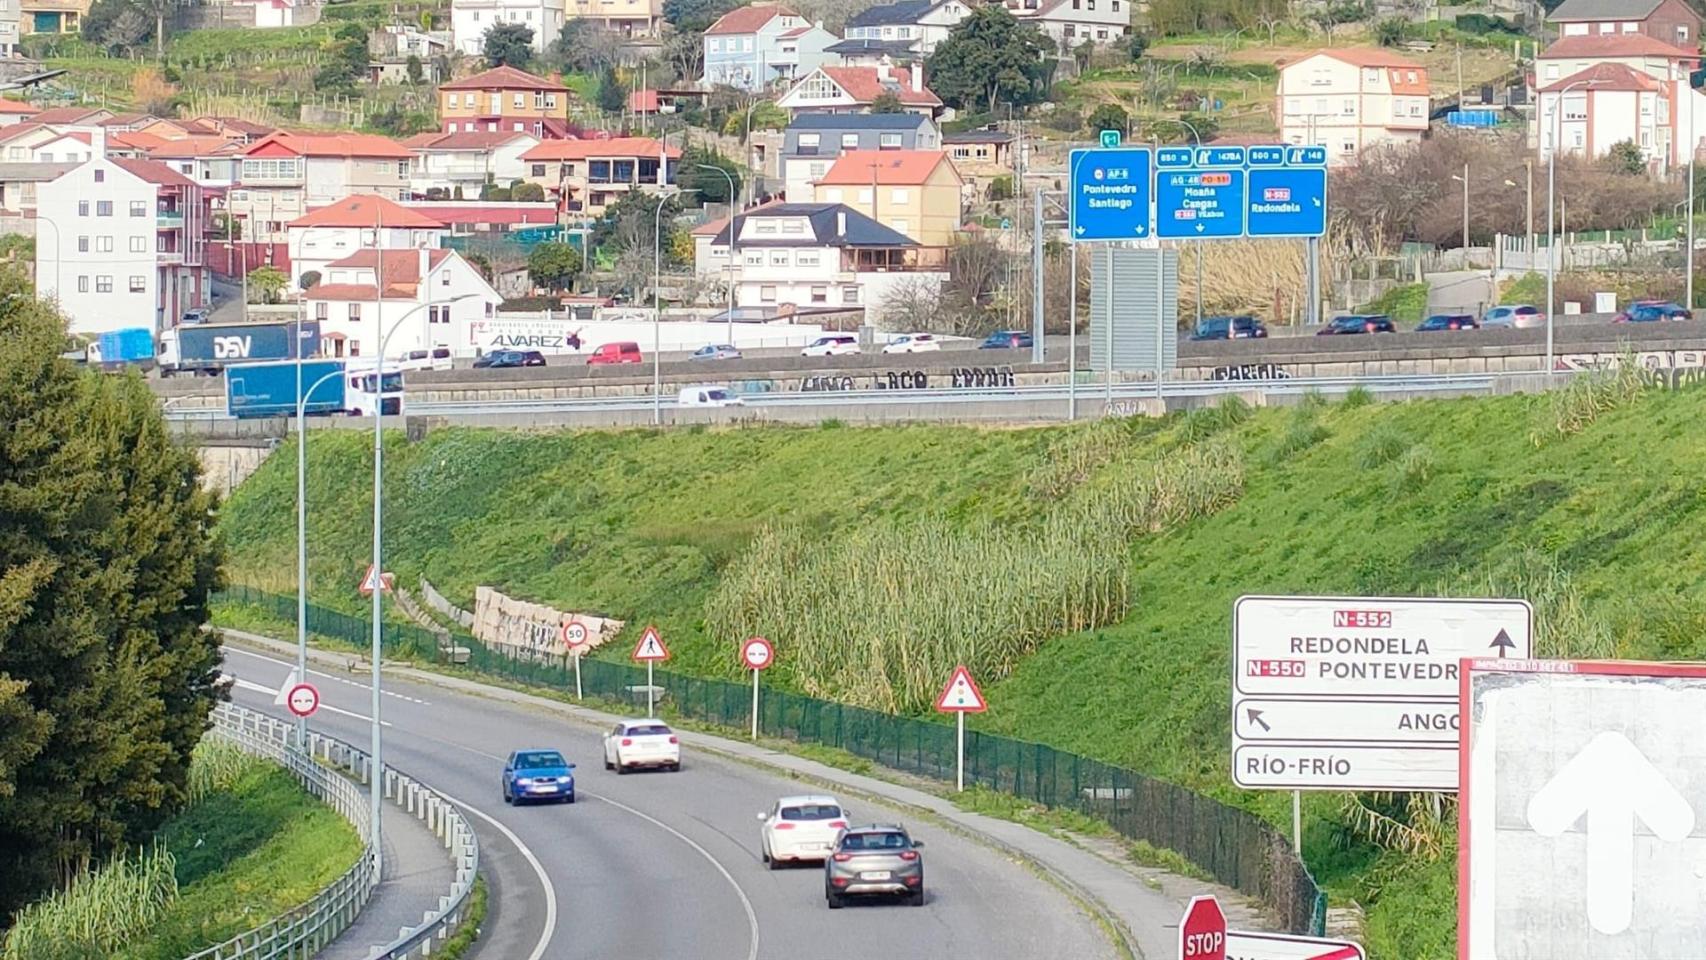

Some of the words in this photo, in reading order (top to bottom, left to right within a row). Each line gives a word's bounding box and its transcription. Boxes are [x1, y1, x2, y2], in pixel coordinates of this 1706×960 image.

[1181, 154, 1189, 162] m
[1272, 152, 1280, 160] m
[1083, 184, 1137, 194] Pontevedra
[1184, 187, 1216, 197] Moaña
[1088, 198, 1133, 210] Santiago
[1182, 199, 1218, 211] Cangas
[1251, 203, 1301, 213] Redondela
[213, 335, 252, 358] DSV
[490, 334, 563, 347] ALVAREZ
[1335, 612, 1391, 627] N-552
[569, 629, 582, 638] 50
[1290, 637, 1430, 655] REDONDELA
[1247, 660, 1306, 676] N-550
[1319, 661, 1458, 680] PONTEVEDR
[1247, 754, 1351, 776] RÍO-FRÍO
[1186, 932, 1223, 956] STOP
